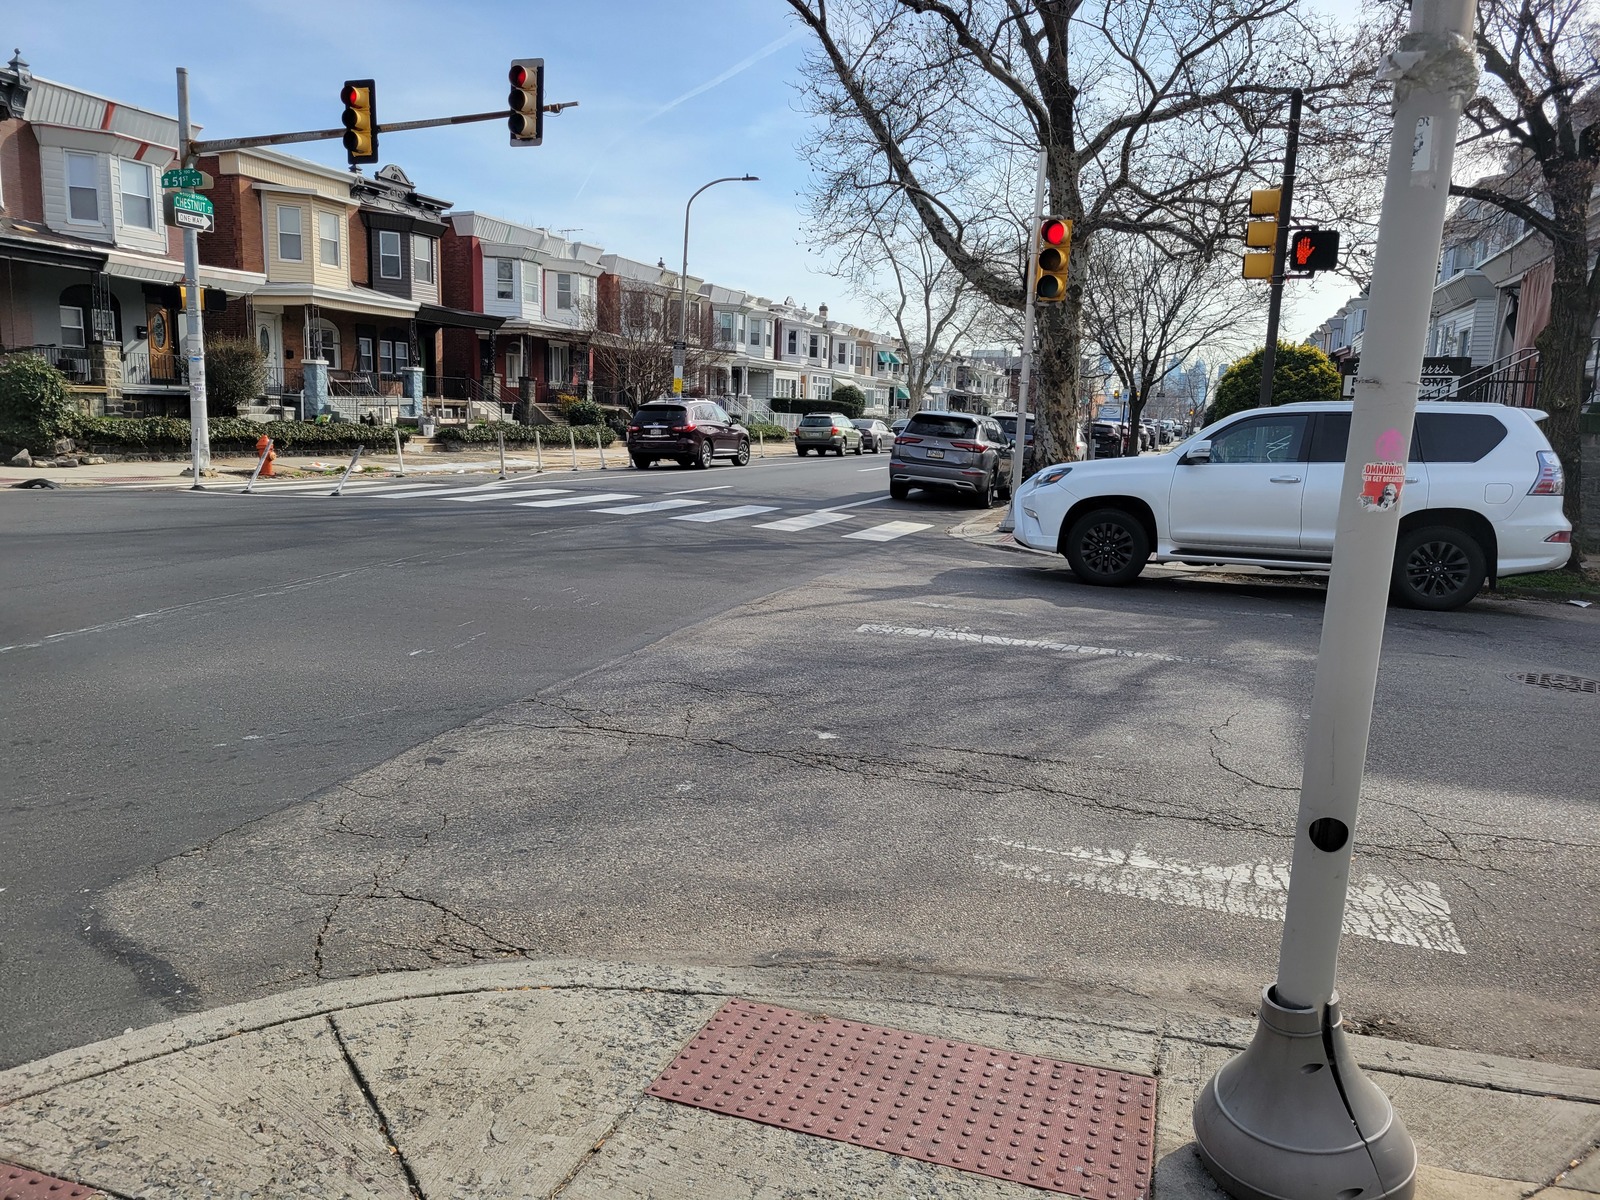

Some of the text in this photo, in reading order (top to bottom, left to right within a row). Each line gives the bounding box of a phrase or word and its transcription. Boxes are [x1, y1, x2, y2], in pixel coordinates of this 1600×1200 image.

[191, 178, 201, 186] ST
[175, 196, 206, 212] CHESTNUT
[179, 214, 203, 224] ONE WAY
[1420, 363, 1454, 374] arris
[1364, 464, 1404, 475] OMMUNIST
